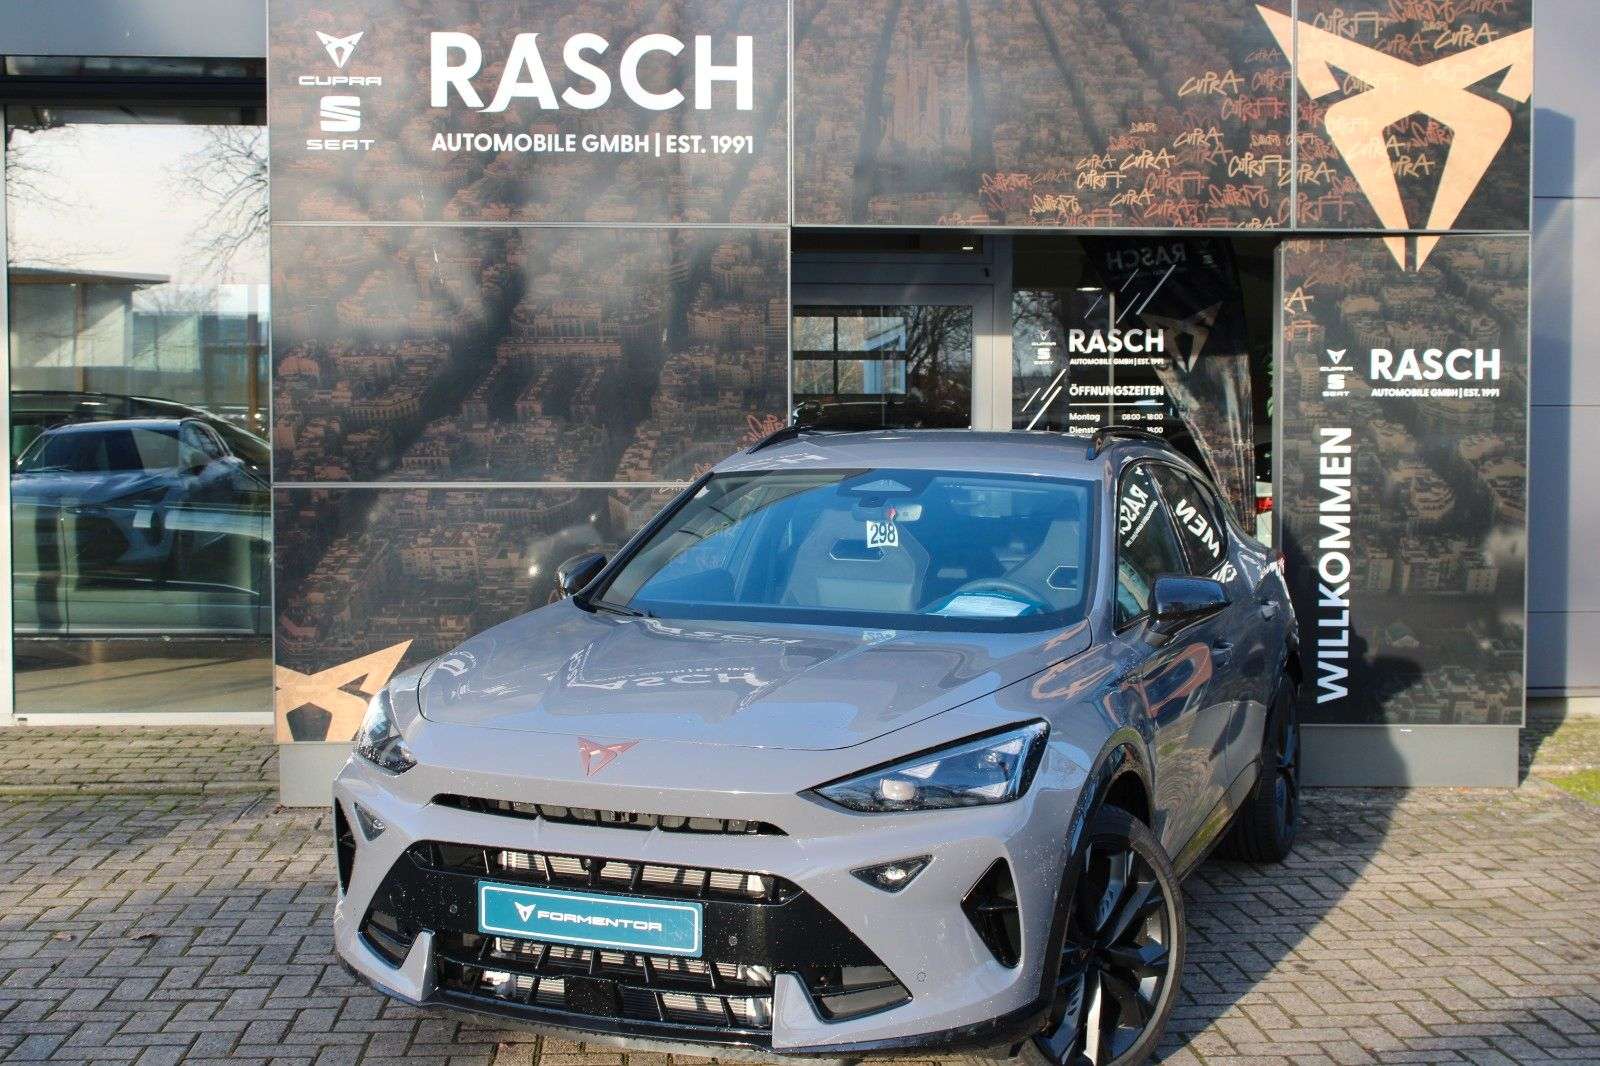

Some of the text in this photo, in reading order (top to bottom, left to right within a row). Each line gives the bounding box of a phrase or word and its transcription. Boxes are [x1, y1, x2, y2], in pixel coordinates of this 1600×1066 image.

[298, 75, 382, 87] CUPRA
[430, 31, 753, 113] RASCH
[1178, 69, 1245, 96] CUPRA
[306, 138, 375, 151] SEAT
[432, 132, 576, 153] AUTOMOBILE
[581, 133, 649, 154] GMBH
[666, 134, 706, 155] EST.
[711, 135, 754, 155] 1991
[1119, 147, 1176, 171] CUPRA
[1277, 161, 1337, 187] CPRA
[1068, 328, 1164, 354] RASCH
[1070, 357, 1112, 366] AUTOMOBILE
[1370, 348, 1500, 382] RASCH
[1069, 384, 1164, 397] ÖFFNUNGSZEITEN
[1371, 388, 1430, 398] AUTOMOBILE
[1430, 388, 1458, 398] GMBH
[1481, 388, 1501, 398] 1991
[1069, 413, 1101, 423] Montag
[1069, 426, 1099, 435] Dienst
[870, 523, 896, 545] 298
[1316, 427, 1352, 704] WILLKOMMEN
[537, 910, 662, 932] FORMENTOR
